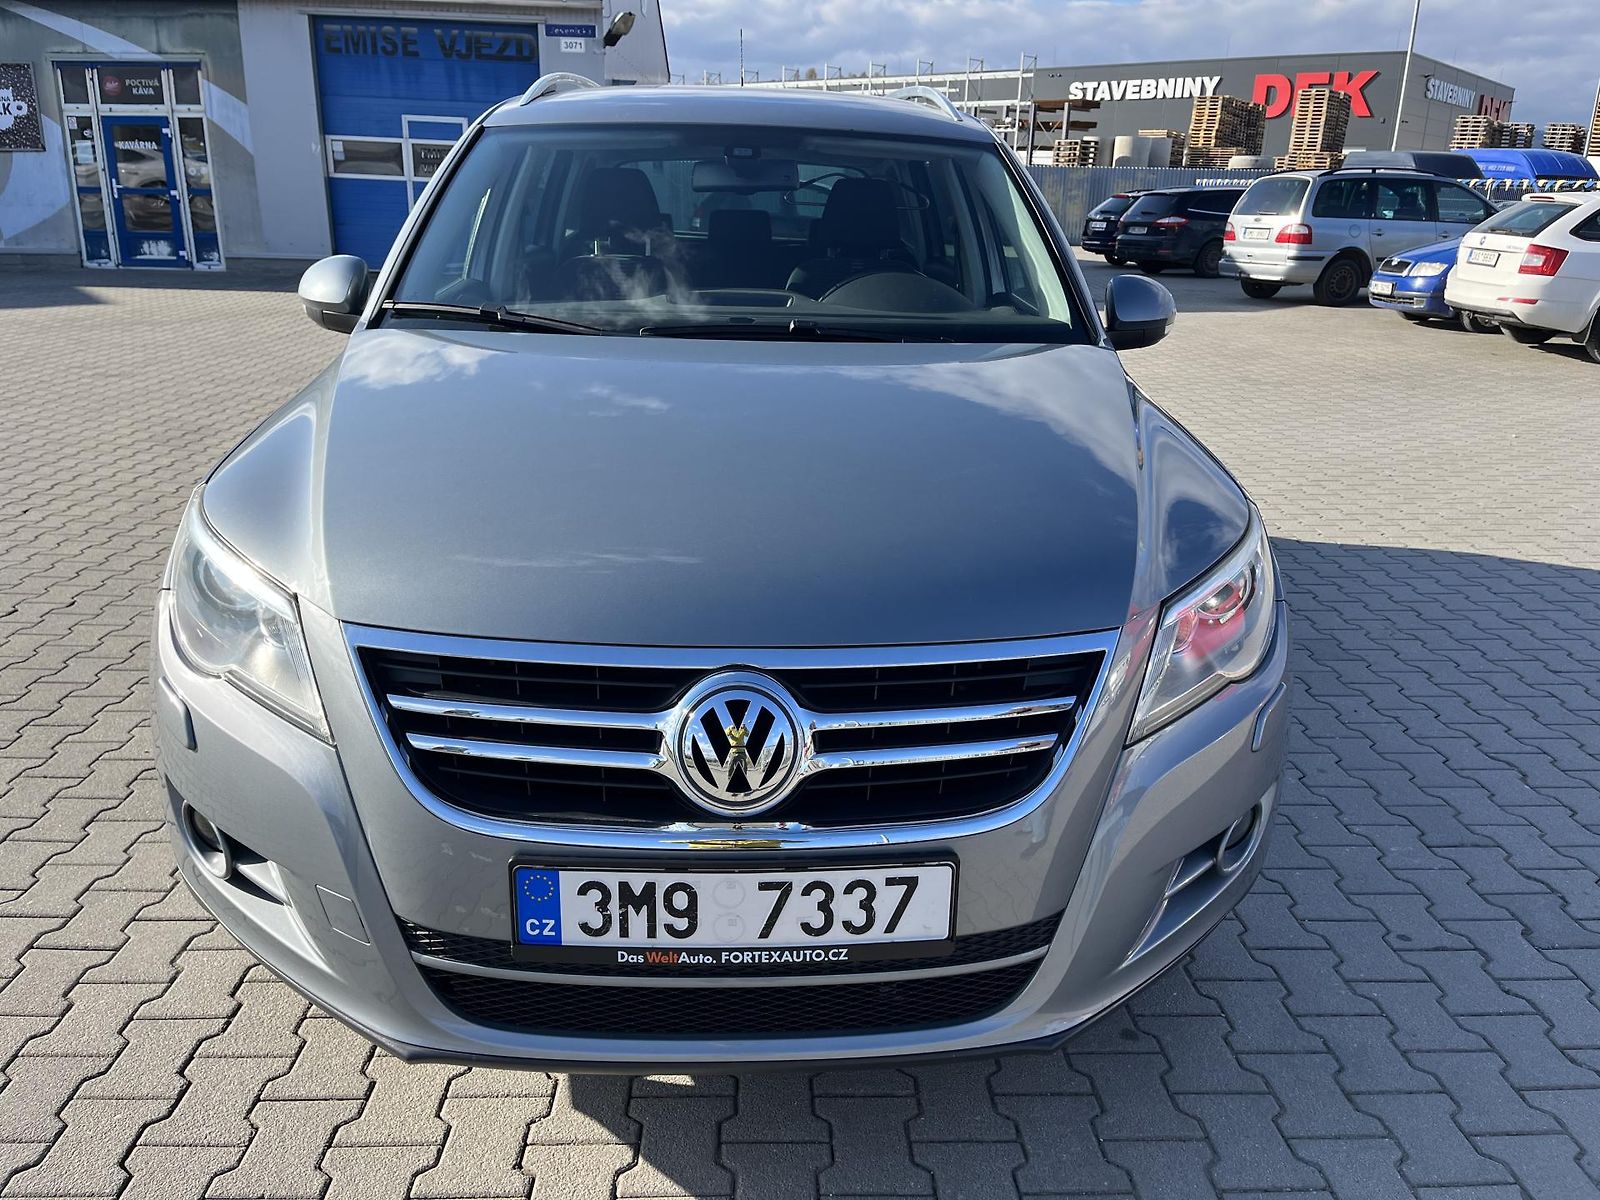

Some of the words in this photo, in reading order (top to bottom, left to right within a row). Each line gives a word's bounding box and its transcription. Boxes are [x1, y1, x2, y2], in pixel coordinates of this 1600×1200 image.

[323, 24, 420, 57] EMISE
[433, 29, 538, 62] VJEZD
[562, 41, 583, 49] 3071
[125, 77, 160, 87] POCTIVÁ
[1068, 75, 1221, 101] STAVEBNINY
[132, 86, 155, 95] KÁVA
[1425, 78, 1476, 110] STAVEBNINY
[118, 139, 158, 150] KAVÁRNA
[576, 880, 699, 940] 3M9
[757, 876, 920, 940] 7337
[525, 918, 556, 937] CZ
[617, 951, 645, 963] Das
[721, 949, 849, 963] FORTEXAUTO.CZ
